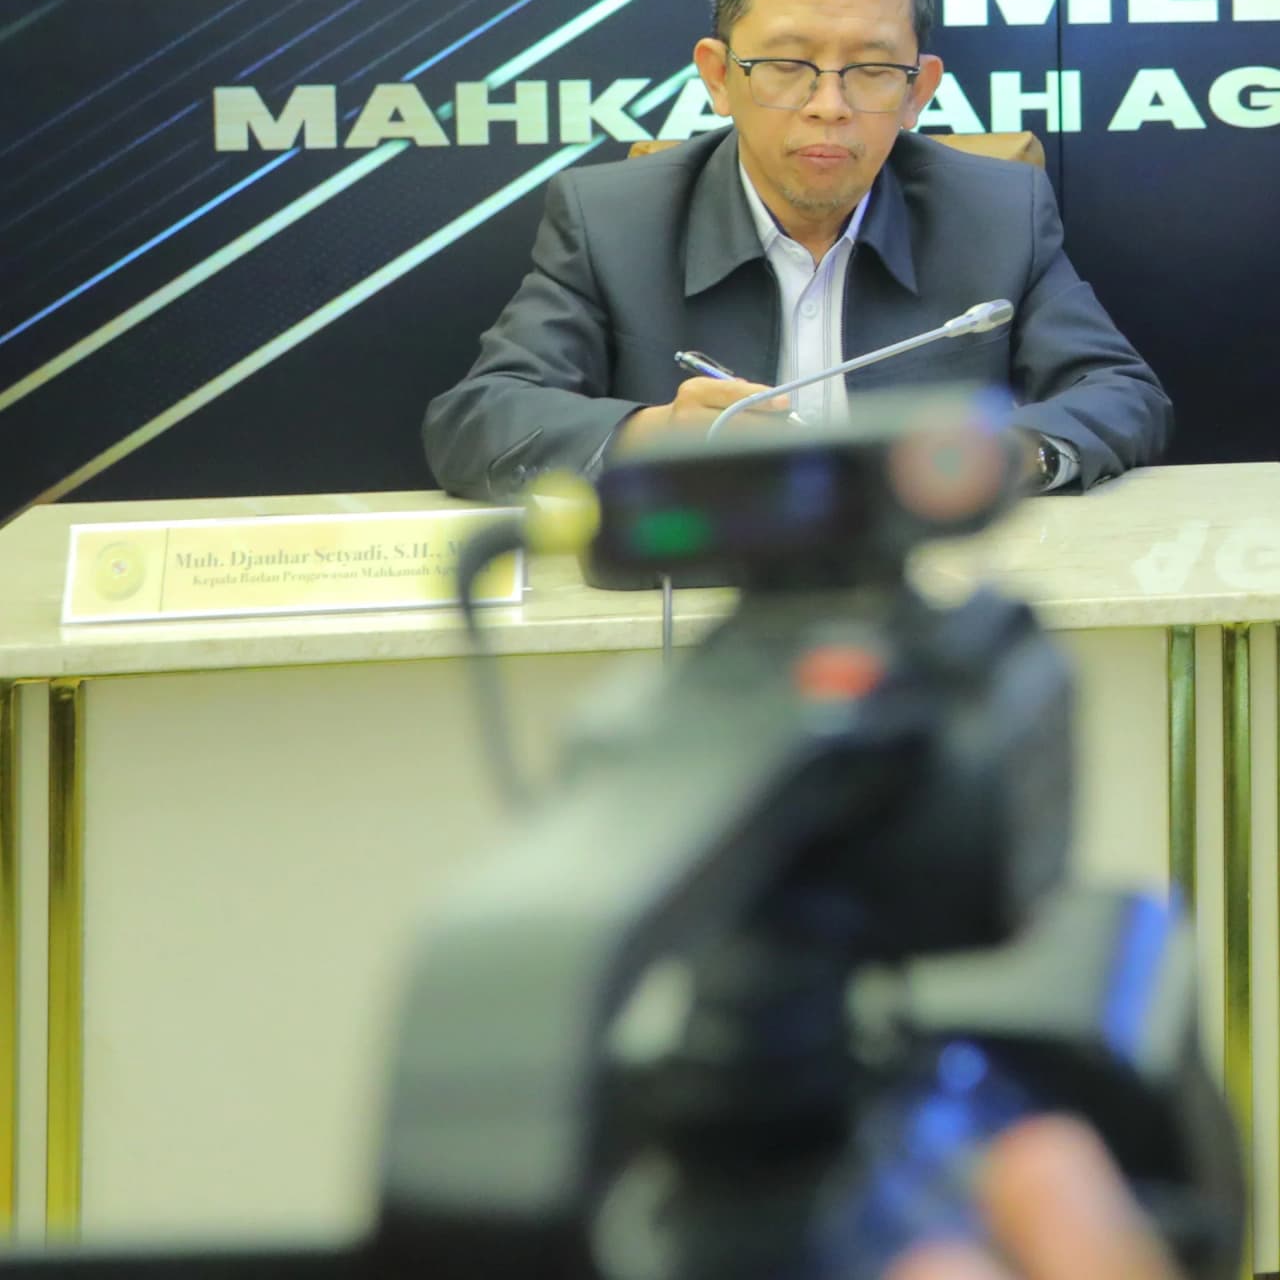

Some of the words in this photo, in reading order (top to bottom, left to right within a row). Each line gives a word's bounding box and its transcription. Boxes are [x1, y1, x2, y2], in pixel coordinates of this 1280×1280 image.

[212, 70, 1082, 152] MAHKAAH
[175, 552, 225, 569] Muh.
[231, 547, 311, 571] Djauhar
